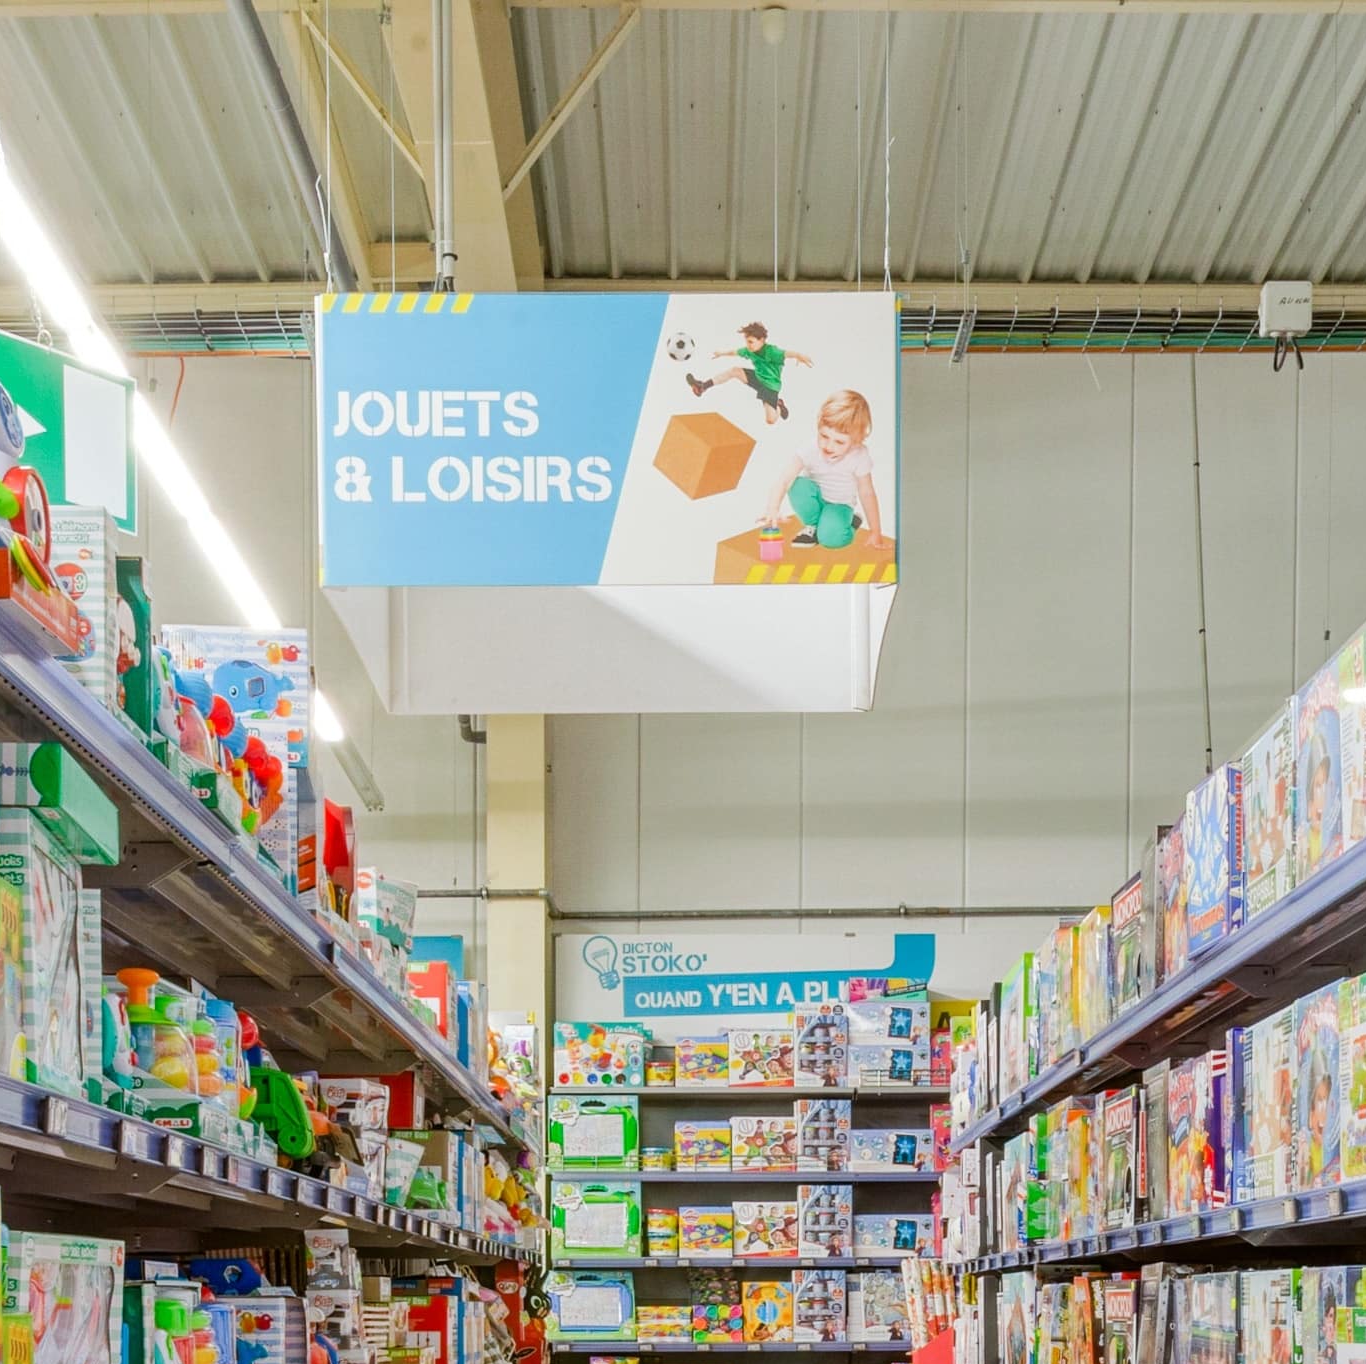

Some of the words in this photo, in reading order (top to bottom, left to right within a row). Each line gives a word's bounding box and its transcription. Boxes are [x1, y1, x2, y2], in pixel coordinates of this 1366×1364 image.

[334, 391, 540, 437] JOUETS
[334, 456, 372, 502] &
[392, 455, 613, 503] LOISIRS
[622, 942, 673, 954] DICTON
[635, 992, 702, 1009] QUAND
[707, 983, 759, 1008] Y'EN
[776, 982, 796, 1005] A
